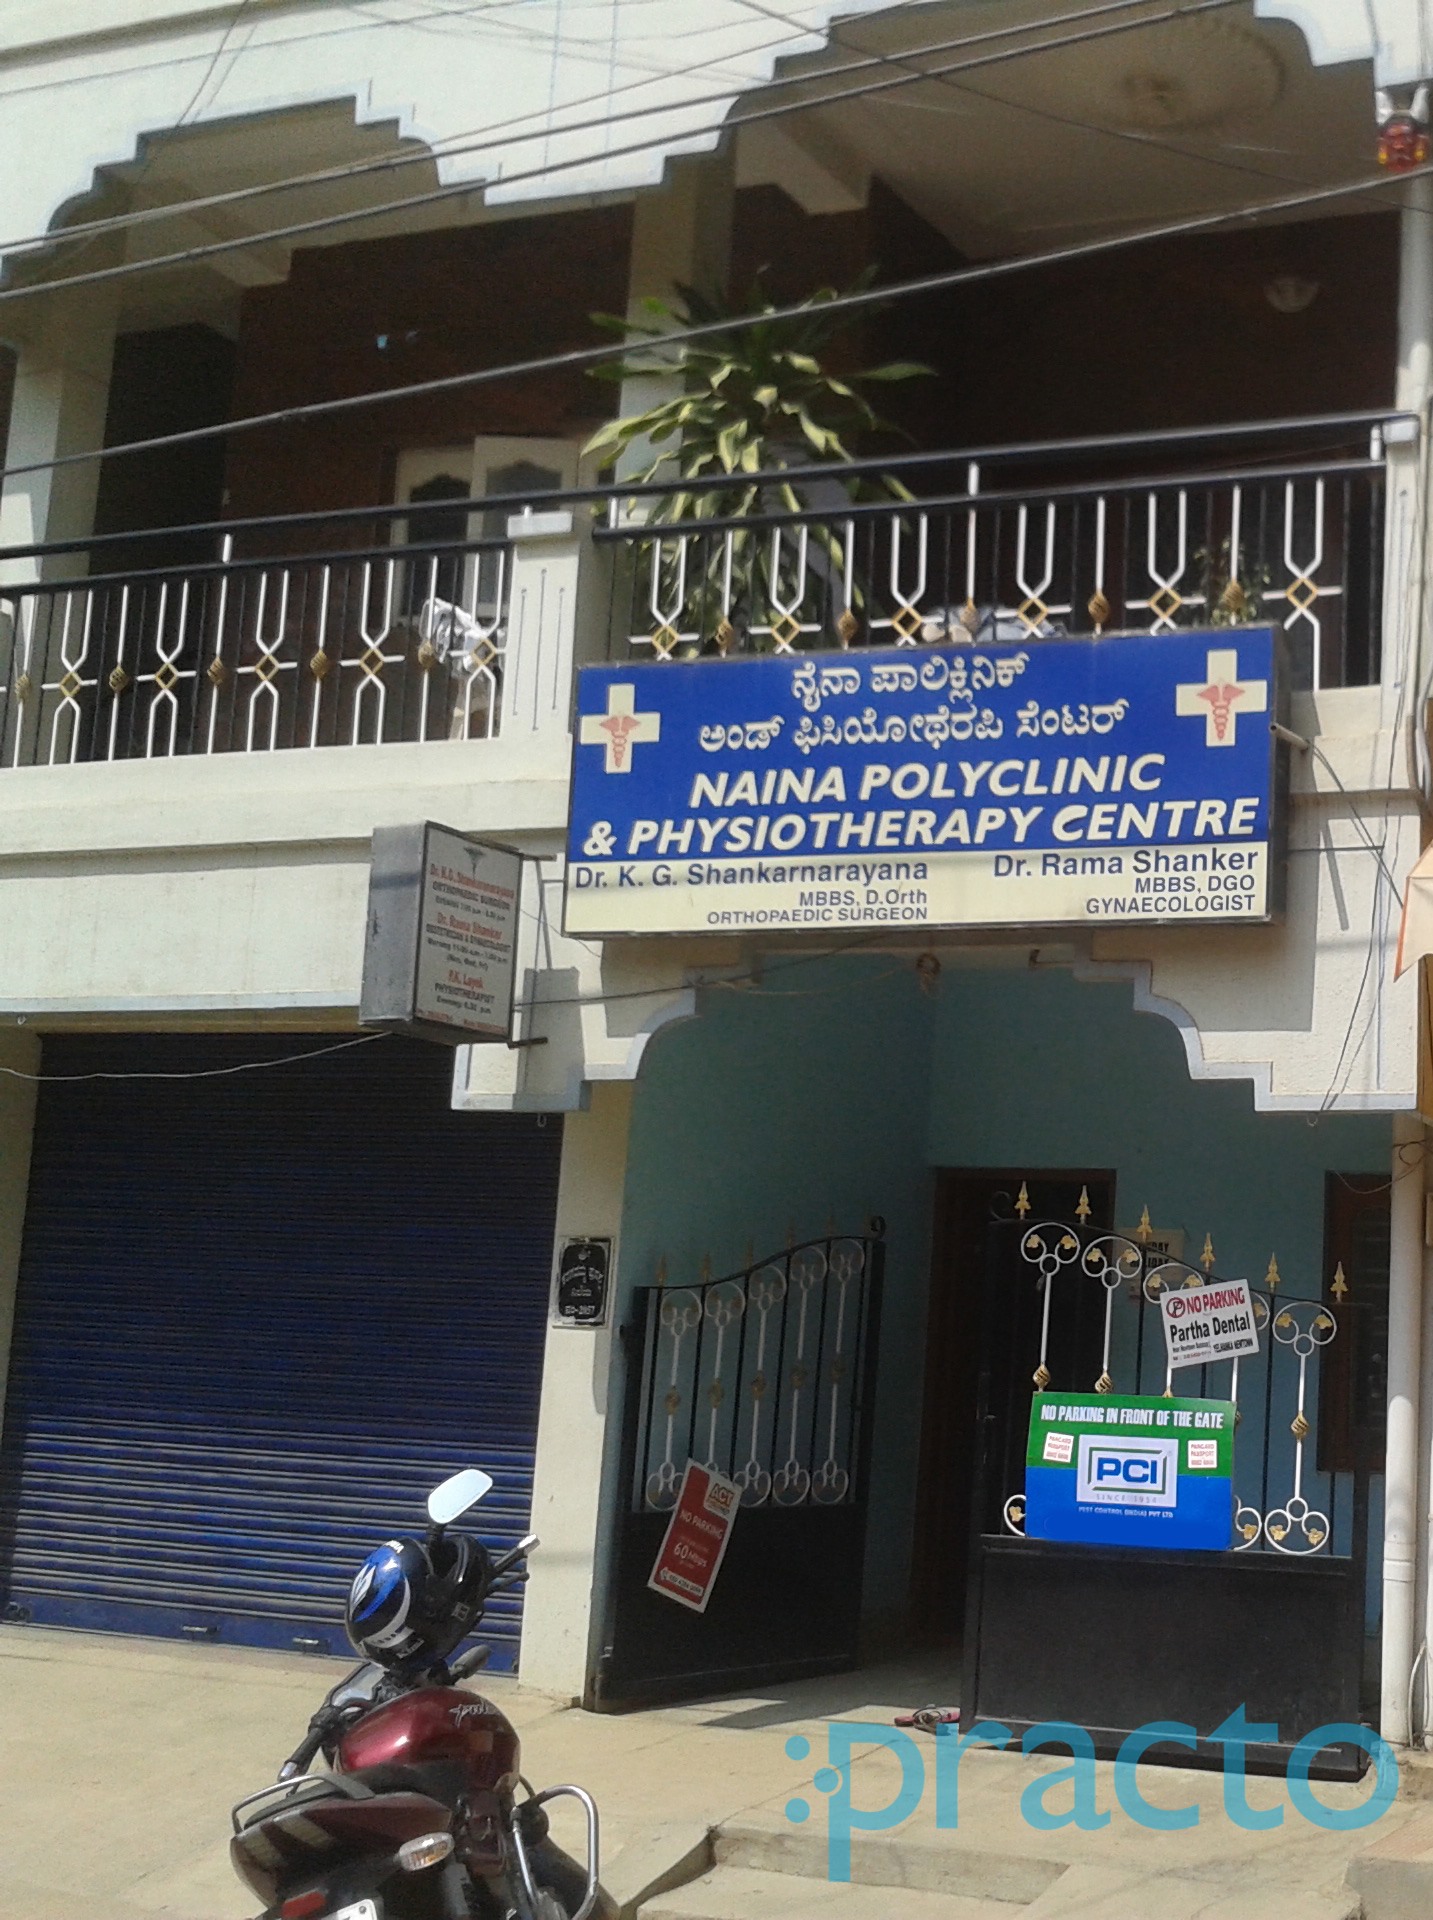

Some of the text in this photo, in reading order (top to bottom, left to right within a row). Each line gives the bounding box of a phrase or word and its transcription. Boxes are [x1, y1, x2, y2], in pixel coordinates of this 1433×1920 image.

[792, 651, 1029, 712] ನೈನಾ ಪಾಲಿಕ್ಲಿನಿಕ್
[700, 715, 785, 752] ಅಂಡ್
[1016, 698, 1130, 738] ಸೆಂಟರ್
[688, 753, 1165, 808] NAINA POLYCLINIC
[583, 797, 1260, 856] & PHYSIOTHERAPY CENTRE
[575, 861, 928, 888] Dr. K. G. Shankarnarayana
[993, 847, 1259, 877] Dr. Rama Shanker
[1134, 875, 1255, 894] MBBS, DGO
[799, 889, 927, 908] MBBS, D.Orth
[1085, 894, 1256, 914] GYNAECOLOGIST
[707, 907, 928, 924] ORTHOPAEDIC SURGEON
[1186, 1287, 1246, 1315] NO PARKING
[1170, 1311, 1251, 1343] Partha Dental
[1040, 1404, 1225, 1429] NO PARKING IN FRONT OF THE GATE
[1096, 1457, 1158, 1484] PCI
[708, 1482, 734, 1507] ACT
[1096, 1493, 1126, 1502] SINCE
[1094, 1507, 1123, 1515] CONTROL
[680, 1510, 724, 1540] NO PARKING
